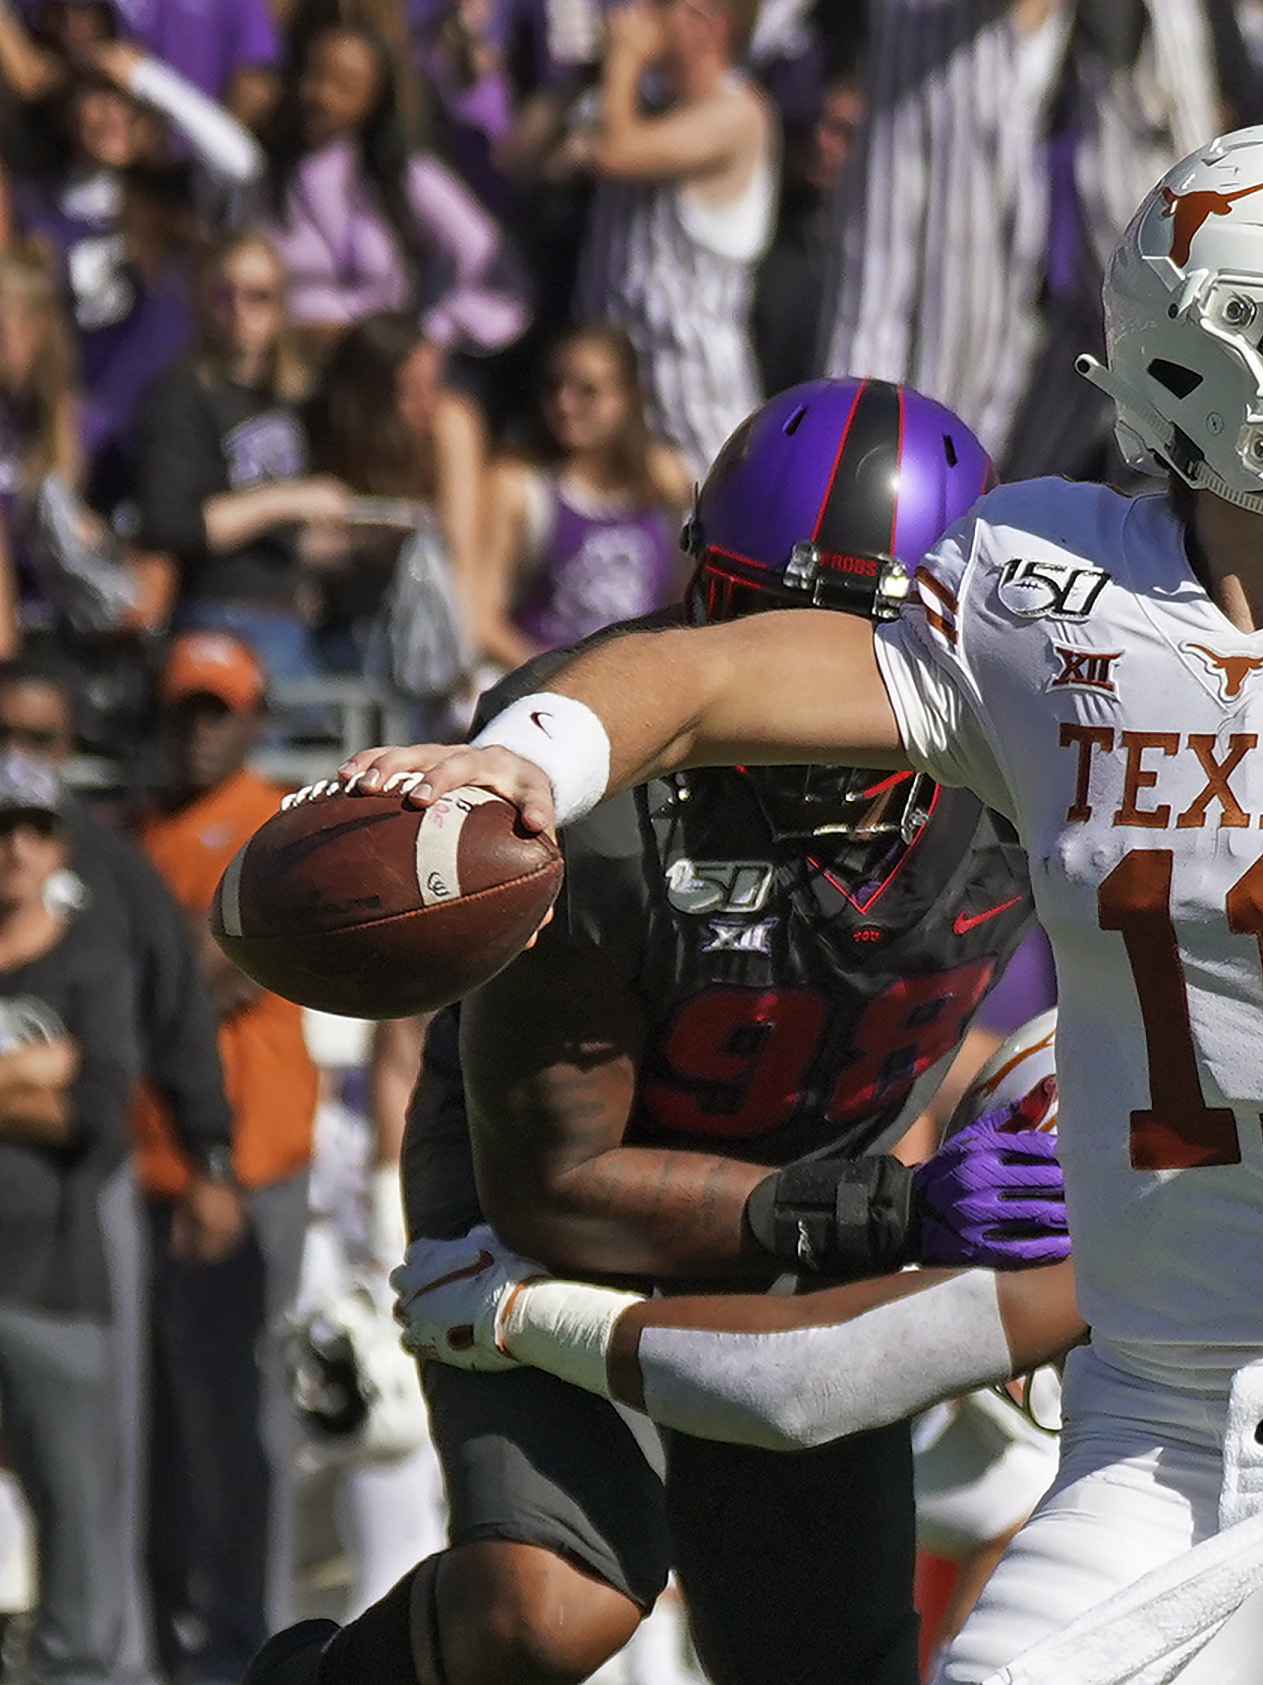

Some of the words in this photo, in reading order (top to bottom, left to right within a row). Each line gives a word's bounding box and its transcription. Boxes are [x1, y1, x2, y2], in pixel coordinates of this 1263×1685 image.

[1000, 558, 1112, 618] 150
[1051, 645, 1124, 692] XII
[650, 958, 996, 1138] 98
